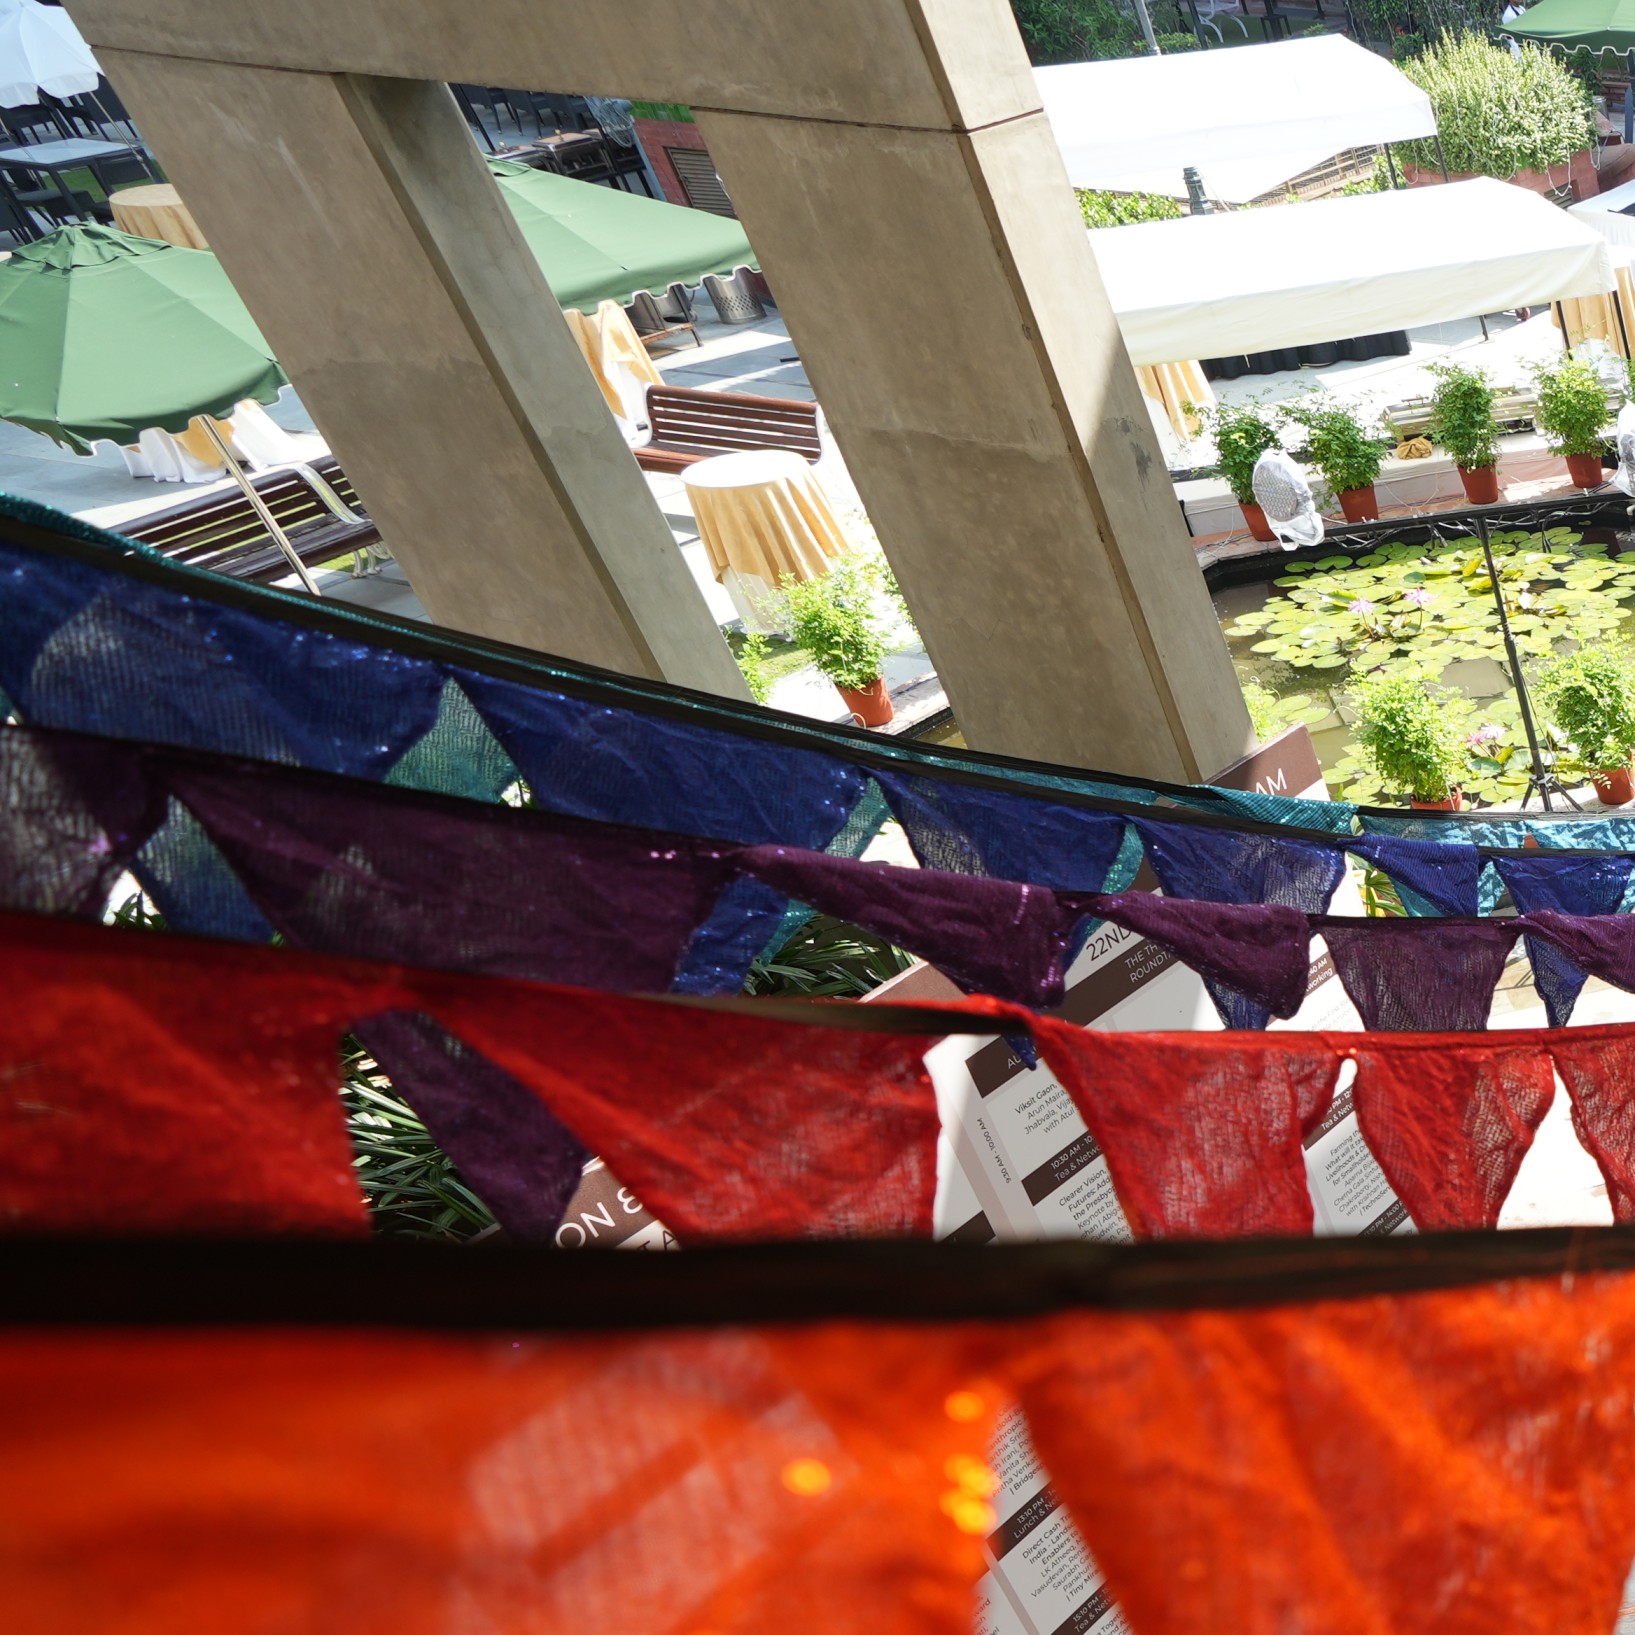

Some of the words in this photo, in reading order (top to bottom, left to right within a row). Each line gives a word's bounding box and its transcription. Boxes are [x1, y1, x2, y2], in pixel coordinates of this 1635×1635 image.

[1125, 951, 1144, 969] THE
[1014, 1097, 1036, 1113] Viksit
[1036, 1082, 1055, 1099] Gaon,
[1024, 1109, 1055, 1134] Jhabvala,
[1028, 1104, 1045, 1119] Arun
[1043, 1119, 1059, 1133] with
[1060, 1108, 1073, 1121] Atul
[1330, 1135, 1352, 1155] Farming
[1051, 1150, 1069, 1171] 10:30
[1069, 1144, 1080, 1156] AM
[1325, 1155, 1340, 1170] What
[1325, 1154, 1354, 1181] Livelihoods
[1054, 1164, 1070, 1183] Tea
[1059, 1185, 1082, 1206] Clearer
[1068, 1190, 1095, 1211] Futures:
[1073, 1209, 1085, 1220] the
[1077, 1206, 1104, 1228] Keynote
[1013, 1515, 1038, 1538] Lunch
[1022, 1537, 1043, 1558] Direct
[1043, 1522, 1060, 1539] Cash
[1041, 1537, 1070, 1564] Enablers
[1029, 1547, 1047, 1564] India
[1052, 1564, 1079, 1590] Saurabh
[1074, 1619, 1088, 1631] Tea
